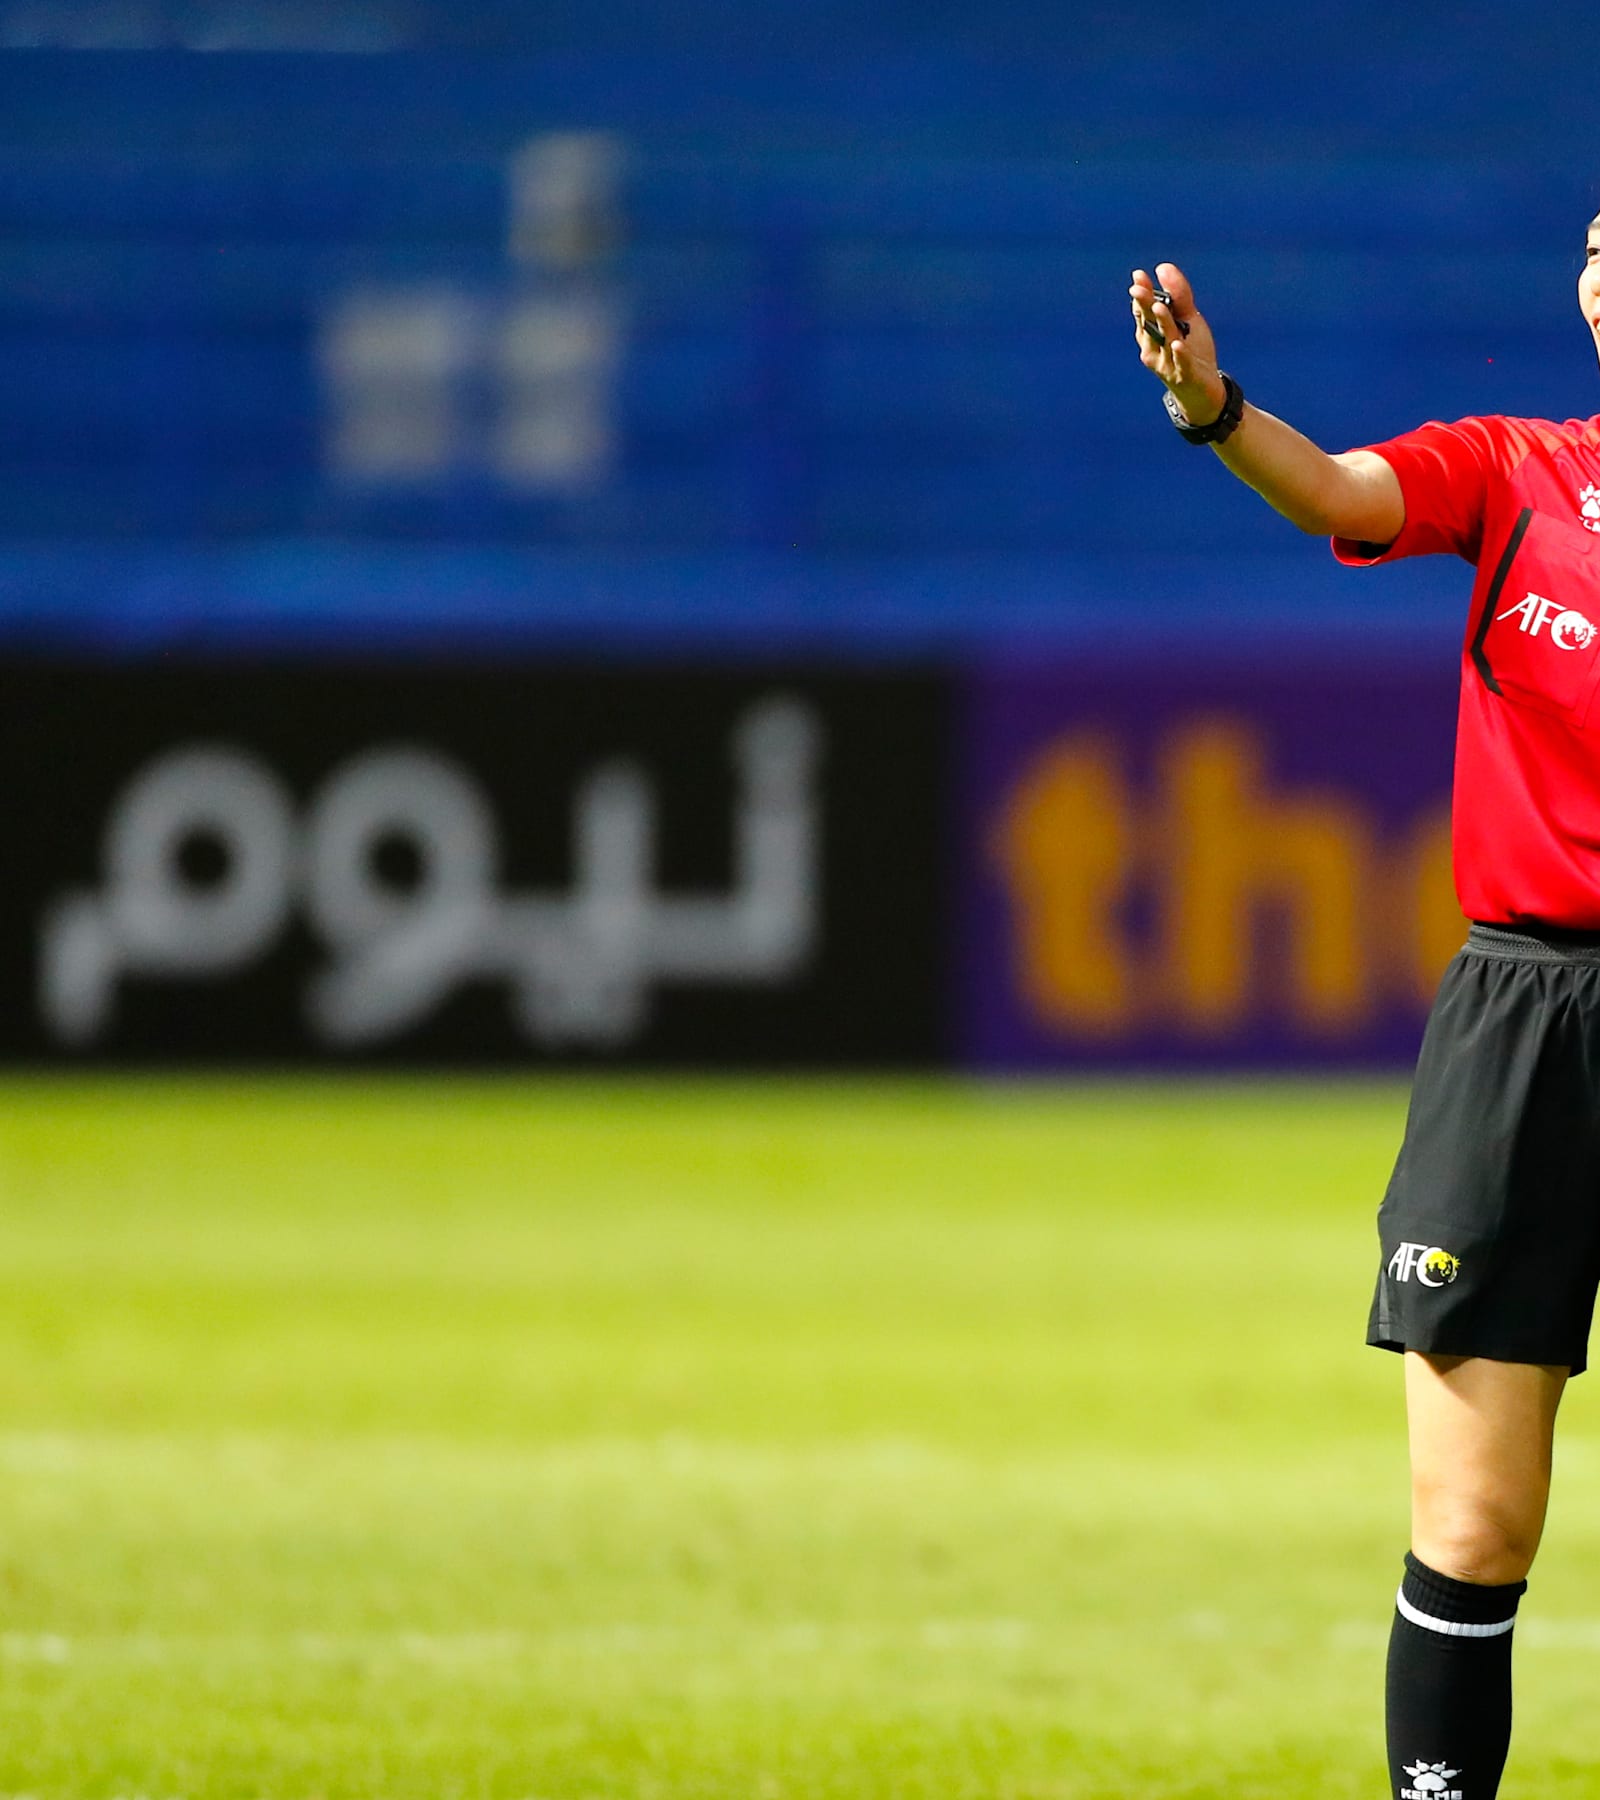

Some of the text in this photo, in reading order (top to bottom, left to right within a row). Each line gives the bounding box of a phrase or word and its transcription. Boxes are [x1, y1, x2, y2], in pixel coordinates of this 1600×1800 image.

[1496, 591, 1598, 650] AFC
[1387, 1241, 1460, 1288] AFC
[1400, 1787, 1463, 1800] KELME
